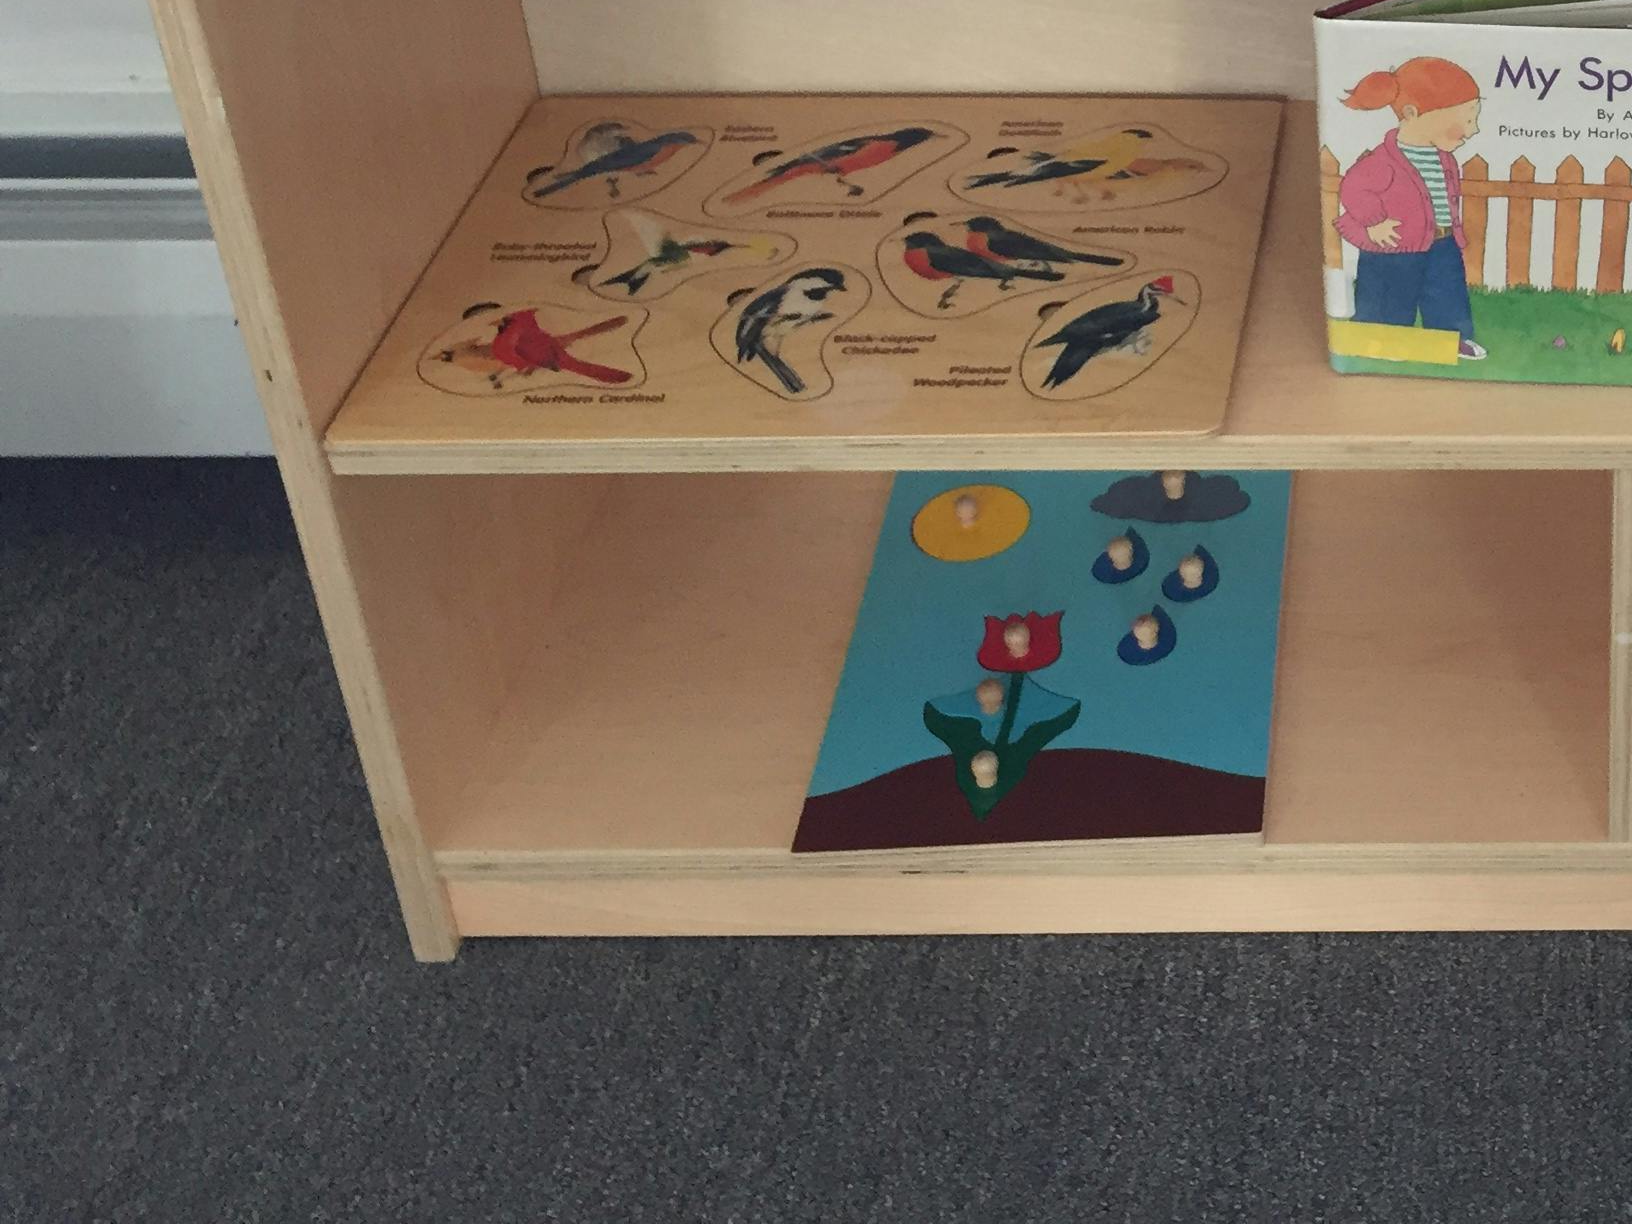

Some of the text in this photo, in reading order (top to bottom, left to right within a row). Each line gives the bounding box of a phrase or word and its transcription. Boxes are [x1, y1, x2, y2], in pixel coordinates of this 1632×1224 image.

[1495, 56, 1560, 100] My
[1597, 109, 1615, 123] By
[1499, 126, 1555, 139] Pictures
[1563, 127, 1580, 139] by
